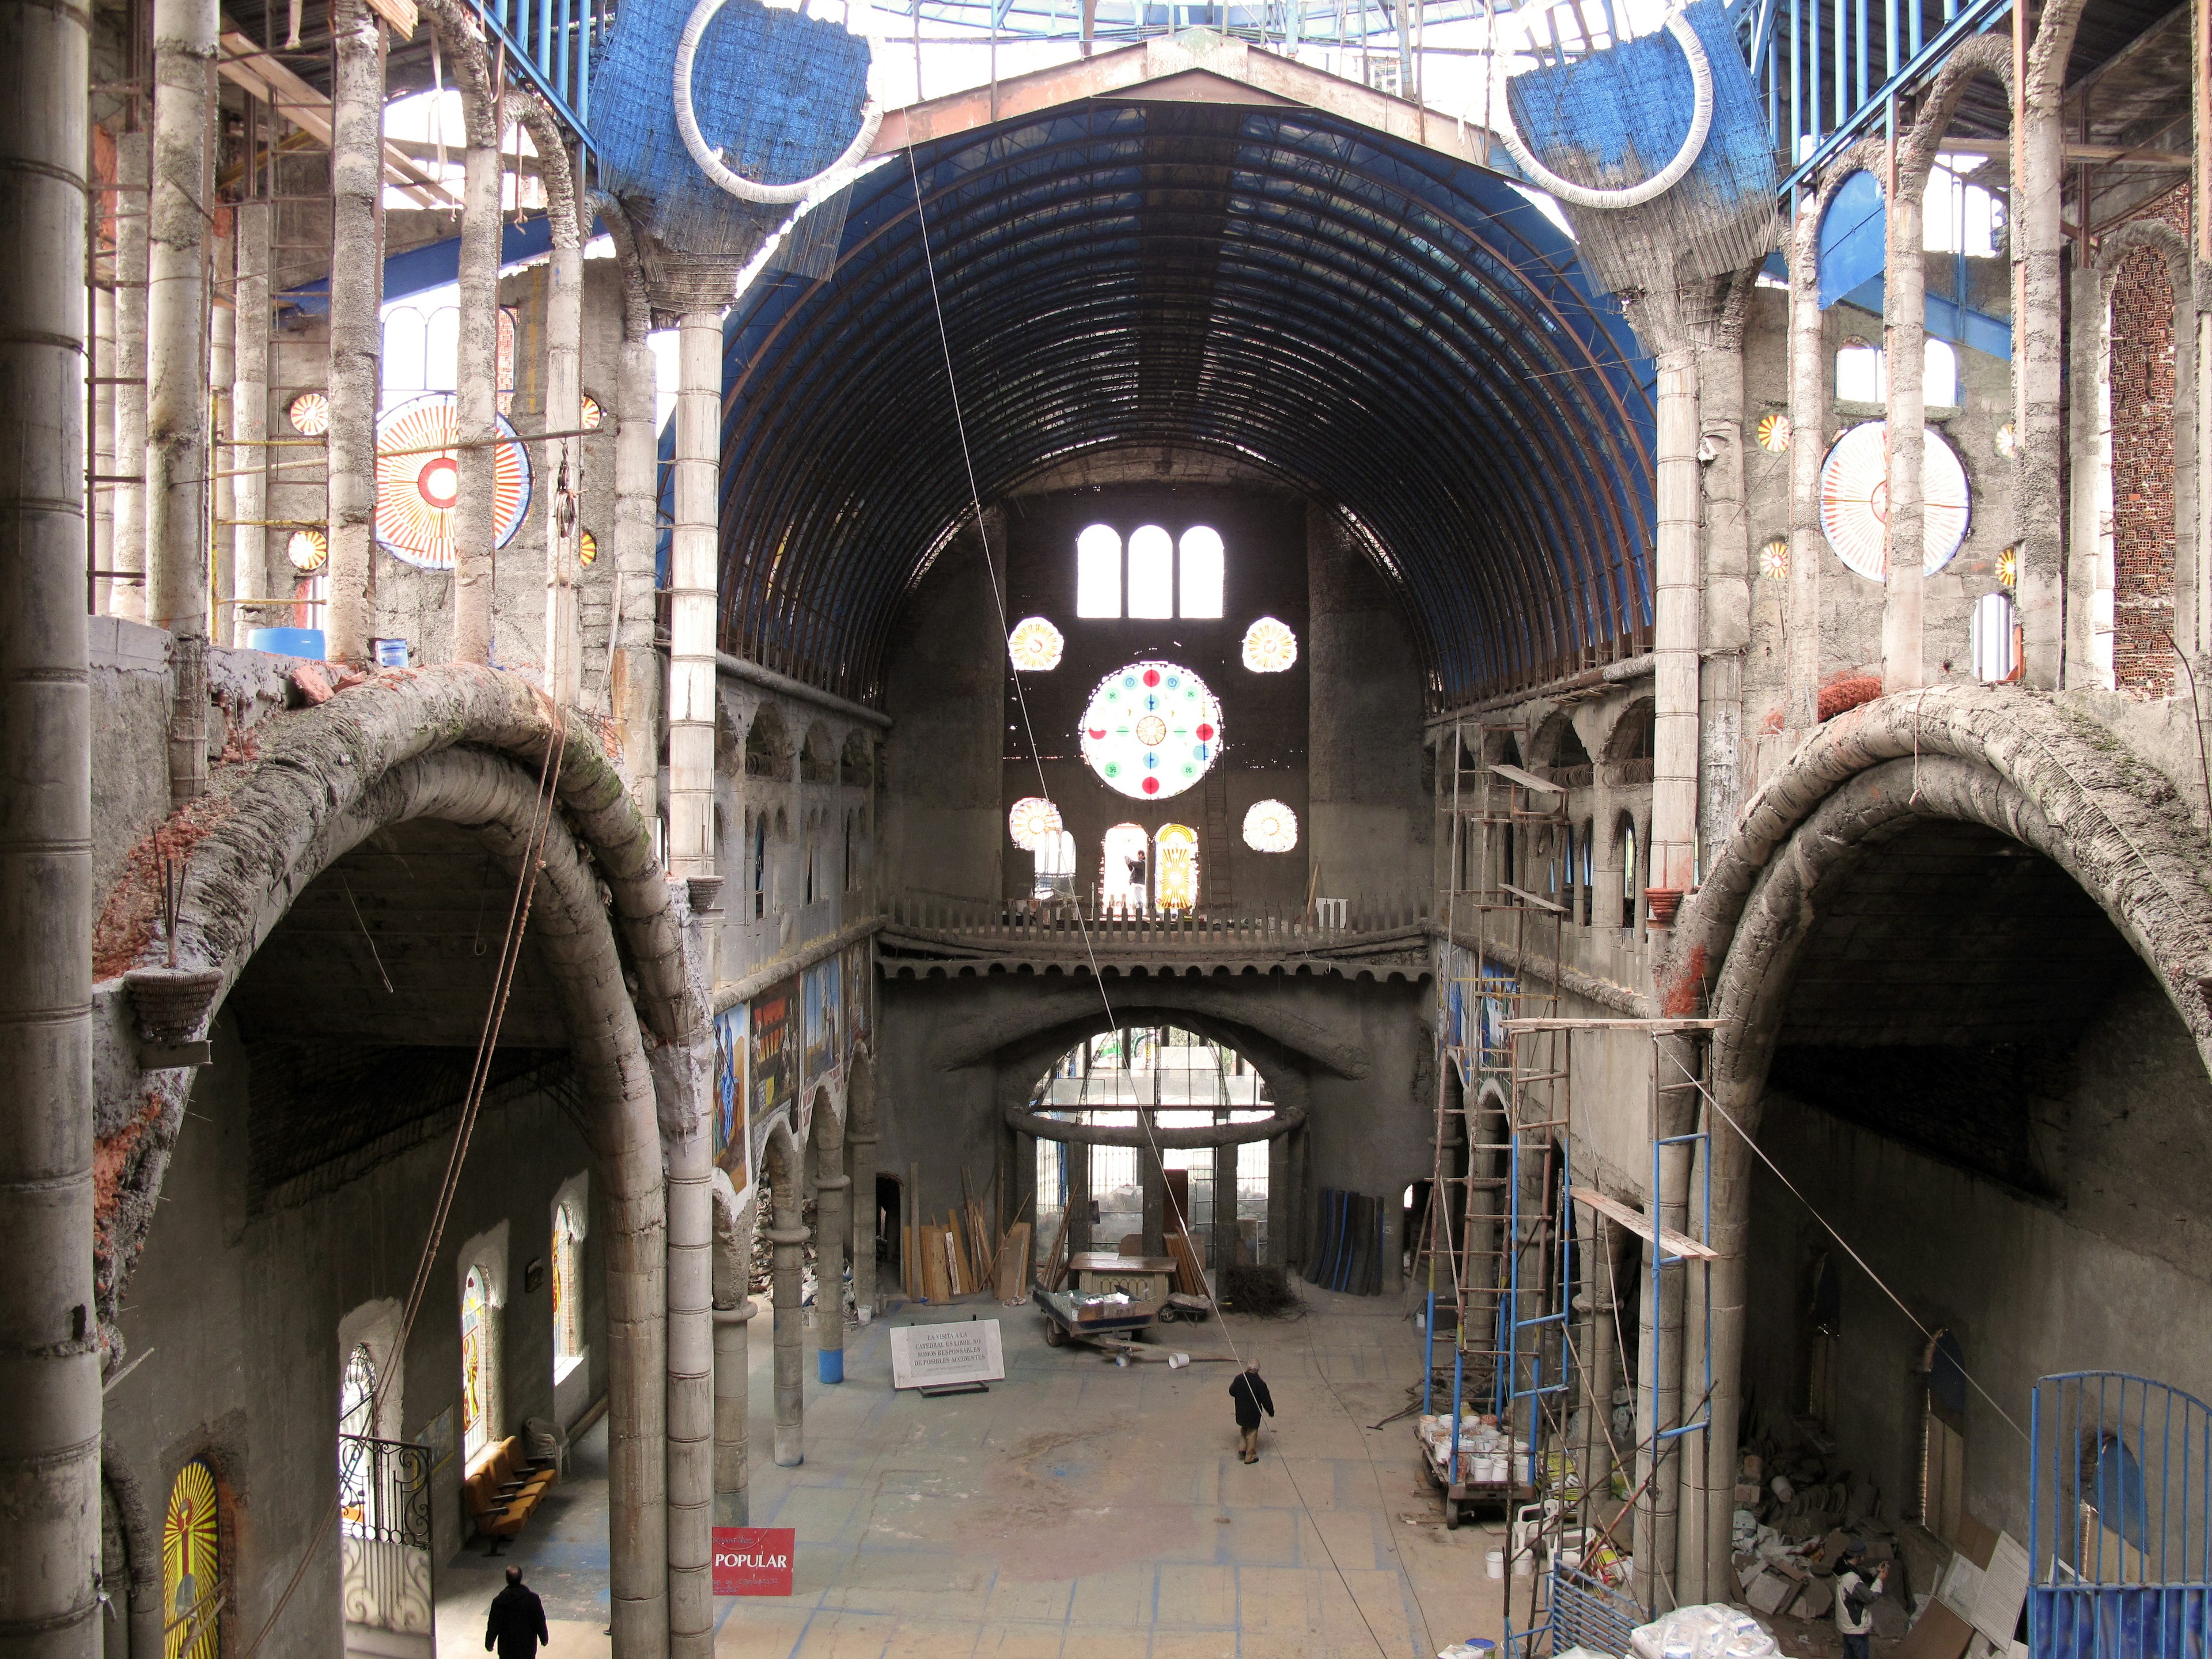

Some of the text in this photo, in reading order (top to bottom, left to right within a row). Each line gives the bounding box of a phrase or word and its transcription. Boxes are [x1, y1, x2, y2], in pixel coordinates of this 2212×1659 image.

[938, 1347, 981, 1356] RESPONSABLES
[923, 1357, 950, 1365] POSIBLES
[952, 1354, 986, 1362] ACCIDENTES
[715, 1554, 787, 1568] POPULAR
